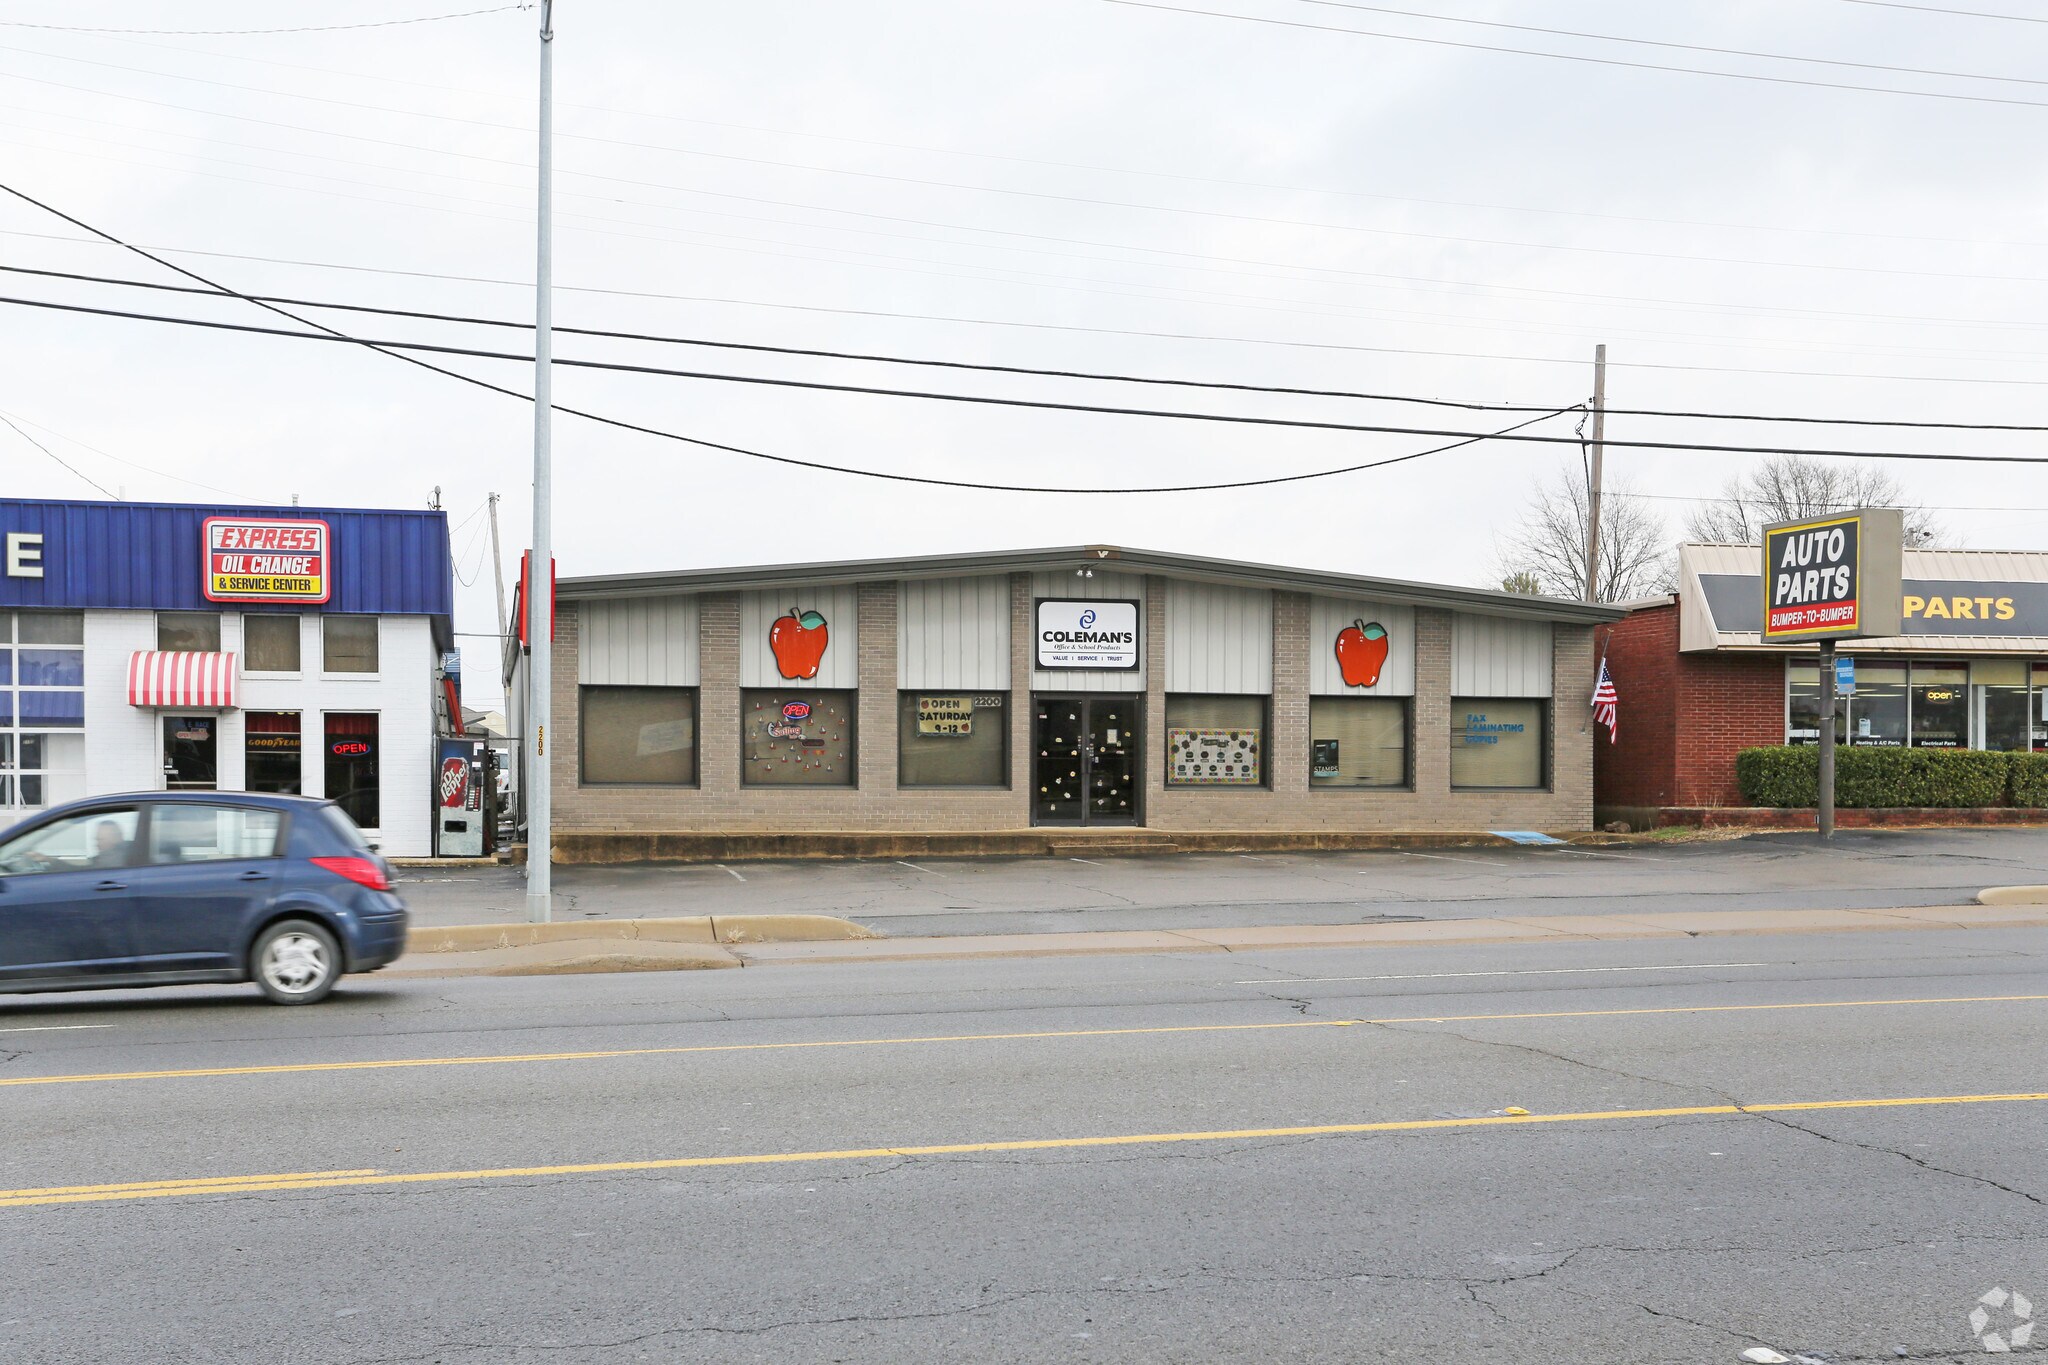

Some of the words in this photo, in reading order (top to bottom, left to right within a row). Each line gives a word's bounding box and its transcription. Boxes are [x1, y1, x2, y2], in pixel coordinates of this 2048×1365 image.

[220, 528, 317, 550] EXPRESS
[1780, 528, 1845, 568] AUTO
[6, 532, 44, 577] E
[221, 555, 246, 573] OIL
[250, 556, 312, 574] CHANGE
[219, 577, 227, 589] &
[230, 577, 270, 590] SERVICE
[273, 578, 311, 591] CENTER
[1775, 565, 1850, 605] PARTS
[1903, 595, 2015, 620] PARTS
[1771, 606, 1854, 626] BUMPER-TO-BUMPER
[1042, 631, 1133, 643] COLEMAN'S
[975, 697, 1001, 706] 2200
[1928, 692, 1953, 700] open
[931, 700, 960, 708] OPEN
[783, 705, 810, 716] OPEN
[919, 712, 972, 721] SATURDAY
[1467, 714, 1486, 722] FAX
[934, 724, 958, 733] 9-12
[1466, 723, 1524, 733] LAMINATING
[333, 743, 367, 754] OPEN
[443, 767, 456, 785] Dr
